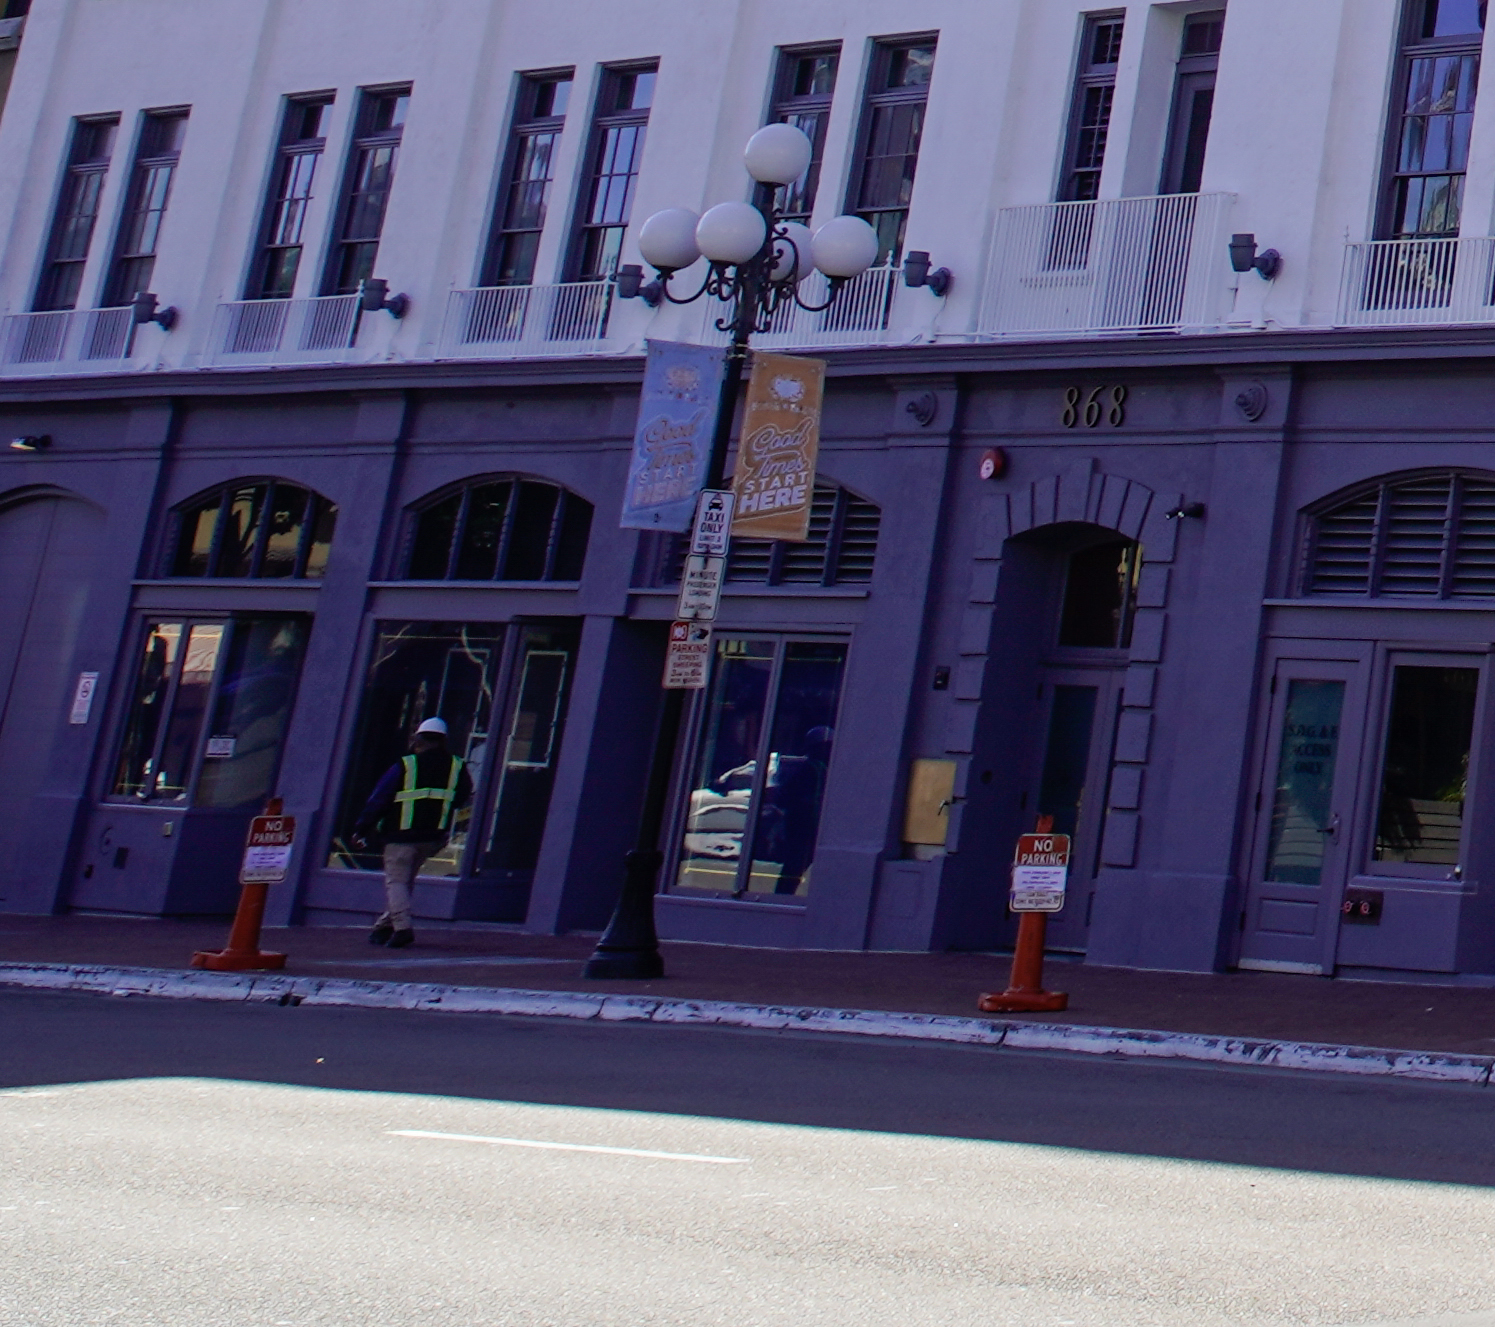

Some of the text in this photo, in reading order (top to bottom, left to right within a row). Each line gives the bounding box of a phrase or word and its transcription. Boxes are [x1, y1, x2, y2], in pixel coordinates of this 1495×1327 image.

[1062, 385, 1127, 429] 868
[753, 421, 814, 454] Good
[744, 472, 809, 494] START
[739, 484, 808, 515] HERE
[704, 512, 725, 522] TAXI
[700, 523, 724, 534] ONLY
[689, 571, 718, 581] MINUTE
[672, 644, 708, 654] PARKING
[1033, 839, 1053, 852] NO
[1021, 853, 1063, 865] PARKING
